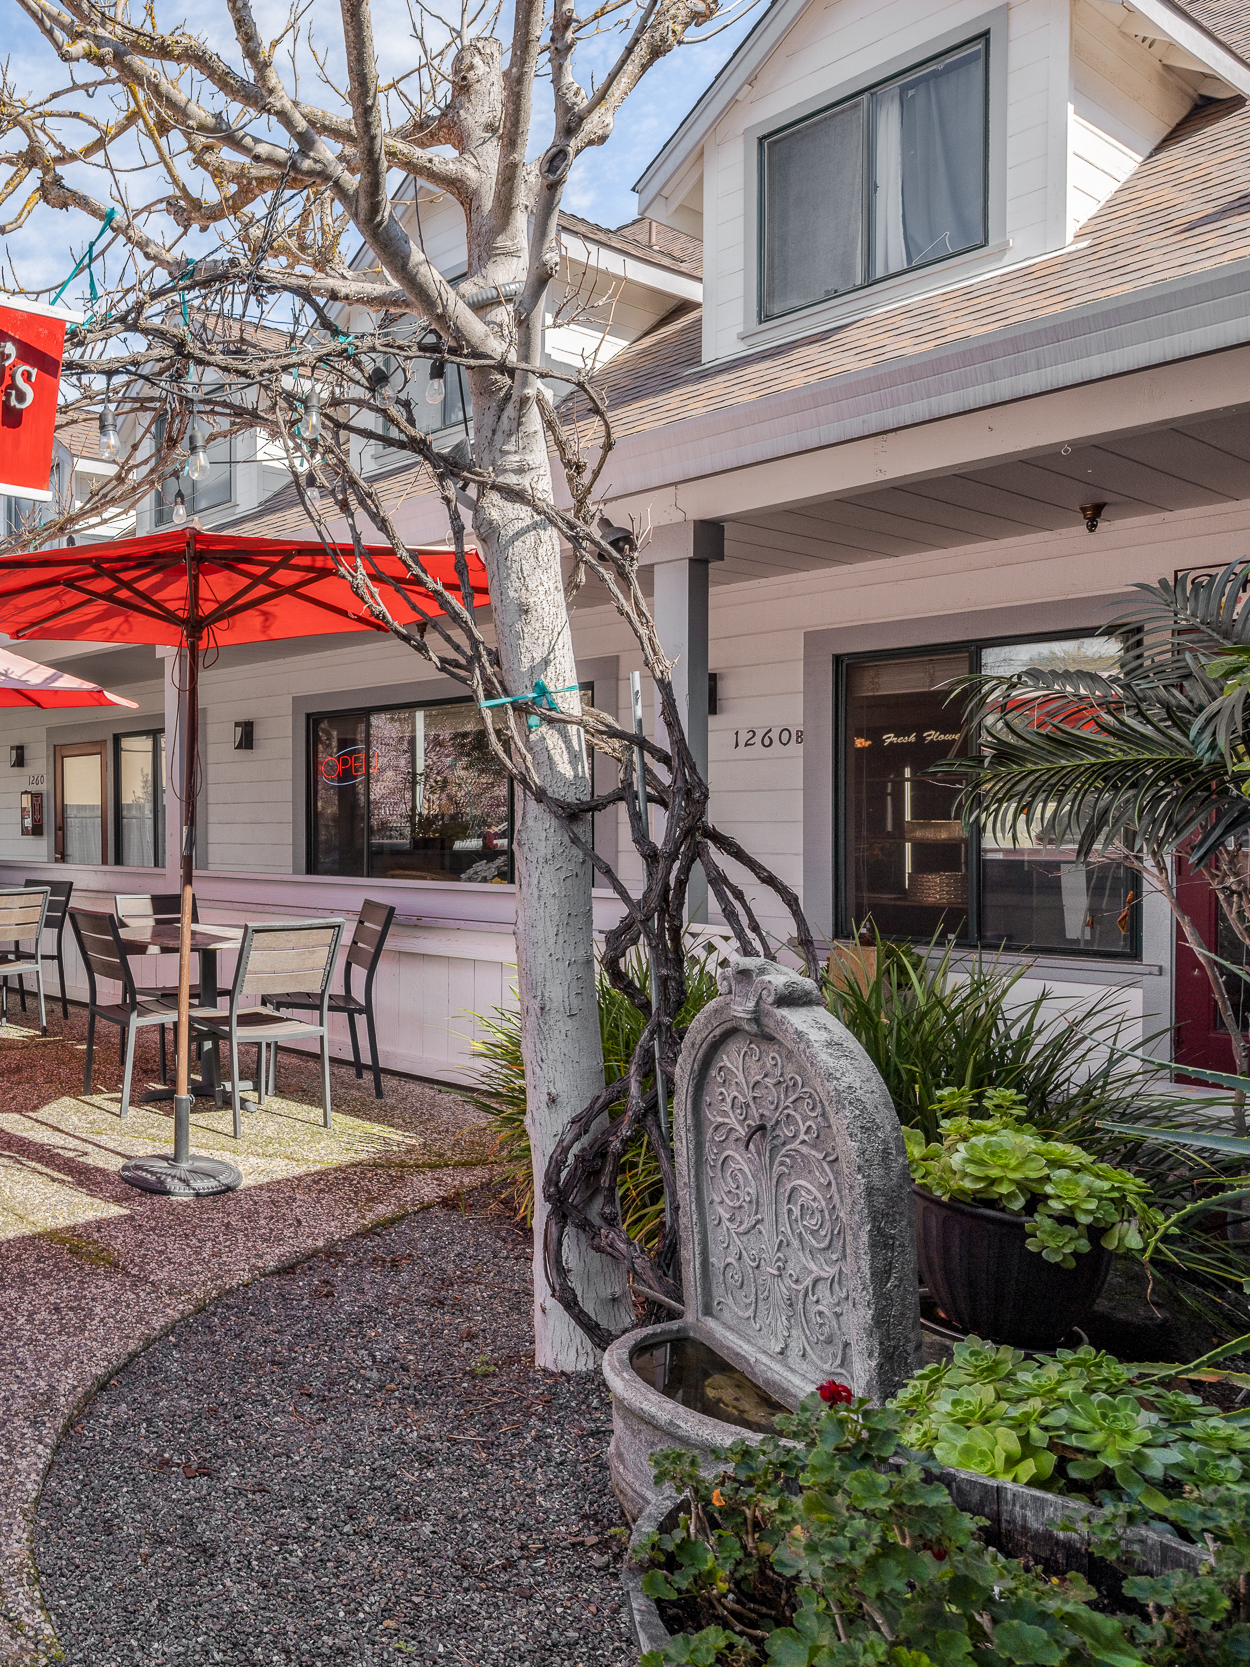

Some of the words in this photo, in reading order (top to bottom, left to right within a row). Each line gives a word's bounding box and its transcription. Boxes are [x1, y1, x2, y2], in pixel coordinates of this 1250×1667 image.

[882, 732, 917, 746] Fresh
[923, 730, 961, 744] Flowe
[28, 775, 45, 786] 1260
